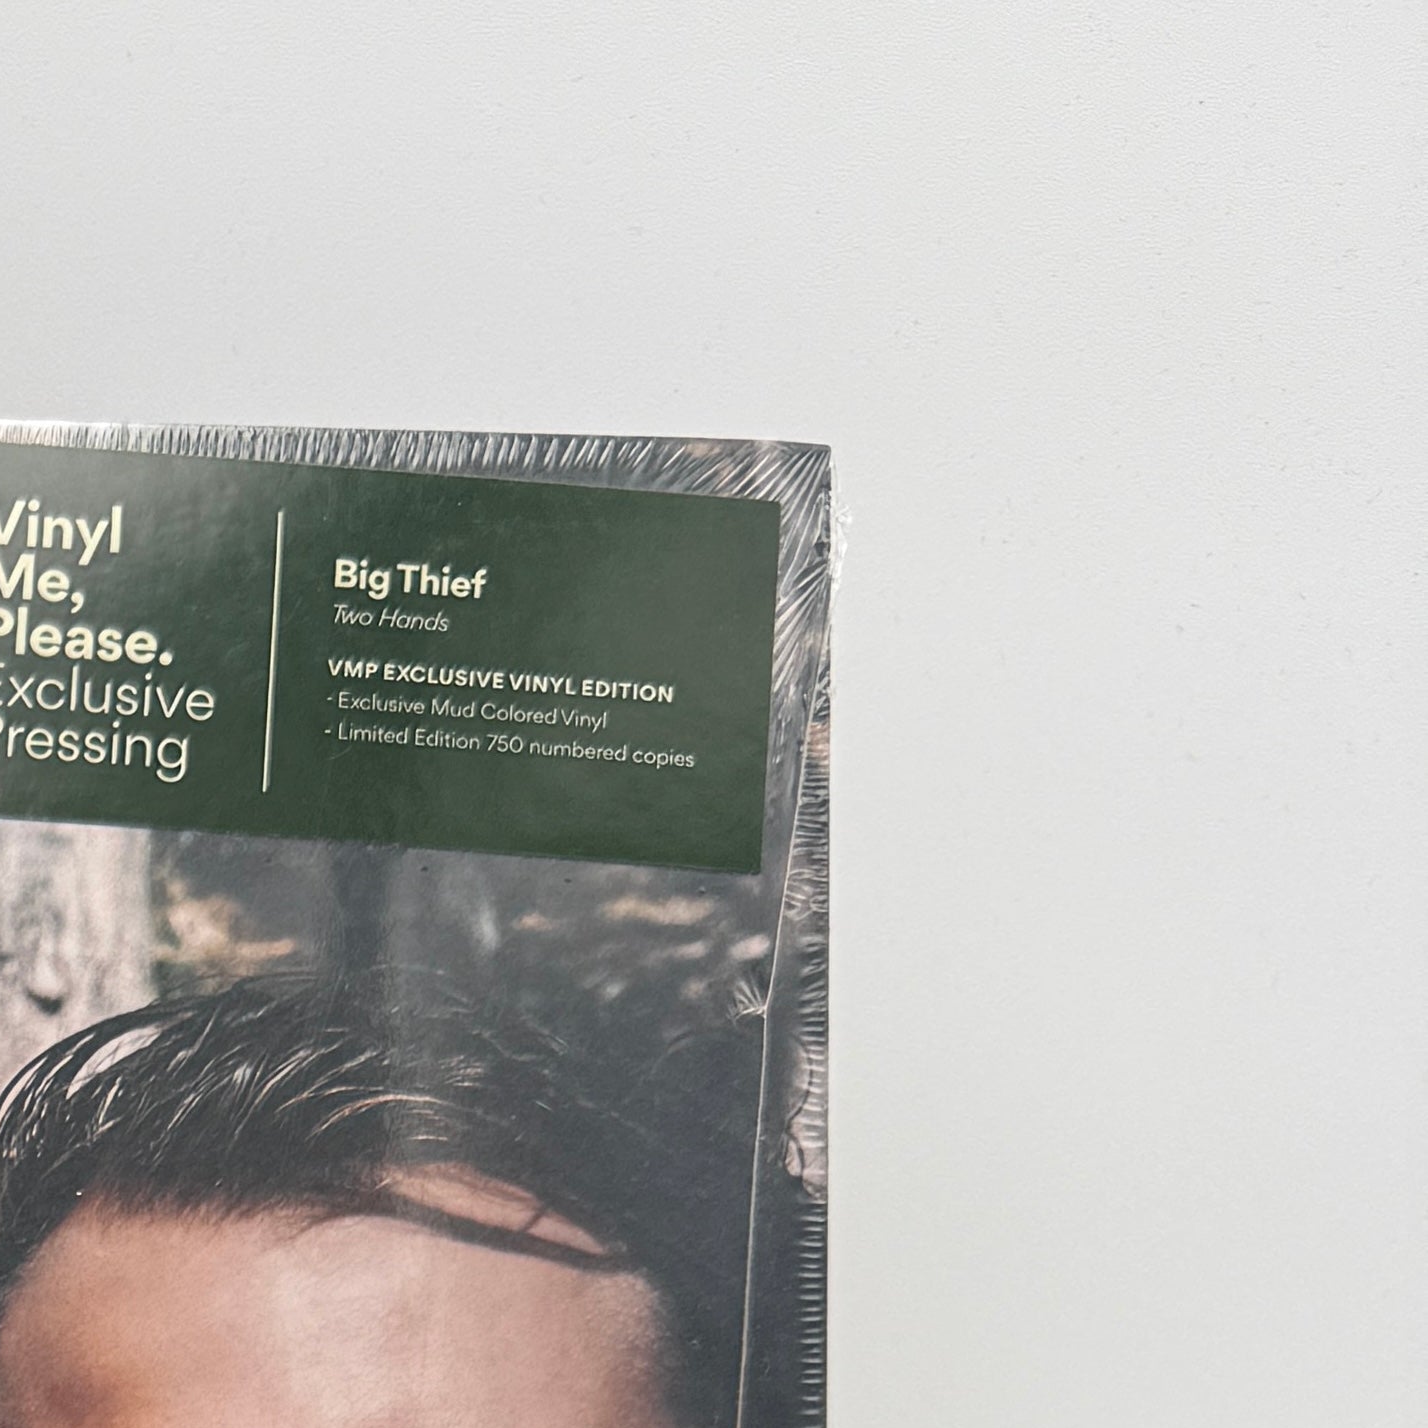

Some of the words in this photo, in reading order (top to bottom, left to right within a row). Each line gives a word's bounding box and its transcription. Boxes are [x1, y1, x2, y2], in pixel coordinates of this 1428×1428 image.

[334, 558, 391, 600] Big
[396, 563, 487, 599] Thief
[333, 603, 374, 626] Two
[378, 607, 450, 632] Hands
[328, 658, 379, 679] VMP
[383, 662, 505, 689] EXCLUSIVE
[509, 673, 577, 695] VINYL
[581, 679, 674, 703] EDITION
[339, 692, 425, 714] Exclusive
[431, 698, 476, 718] Mud
[480, 702, 558, 725] Colored
[560, 708, 608, 734] Vinyl
[338, 722, 409, 745] Limited
[414, 728, 481, 750] Edition
[486, 733, 525, 754] 750
[529, 740, 628, 762] numbered
[632, 750, 695, 770] copies
